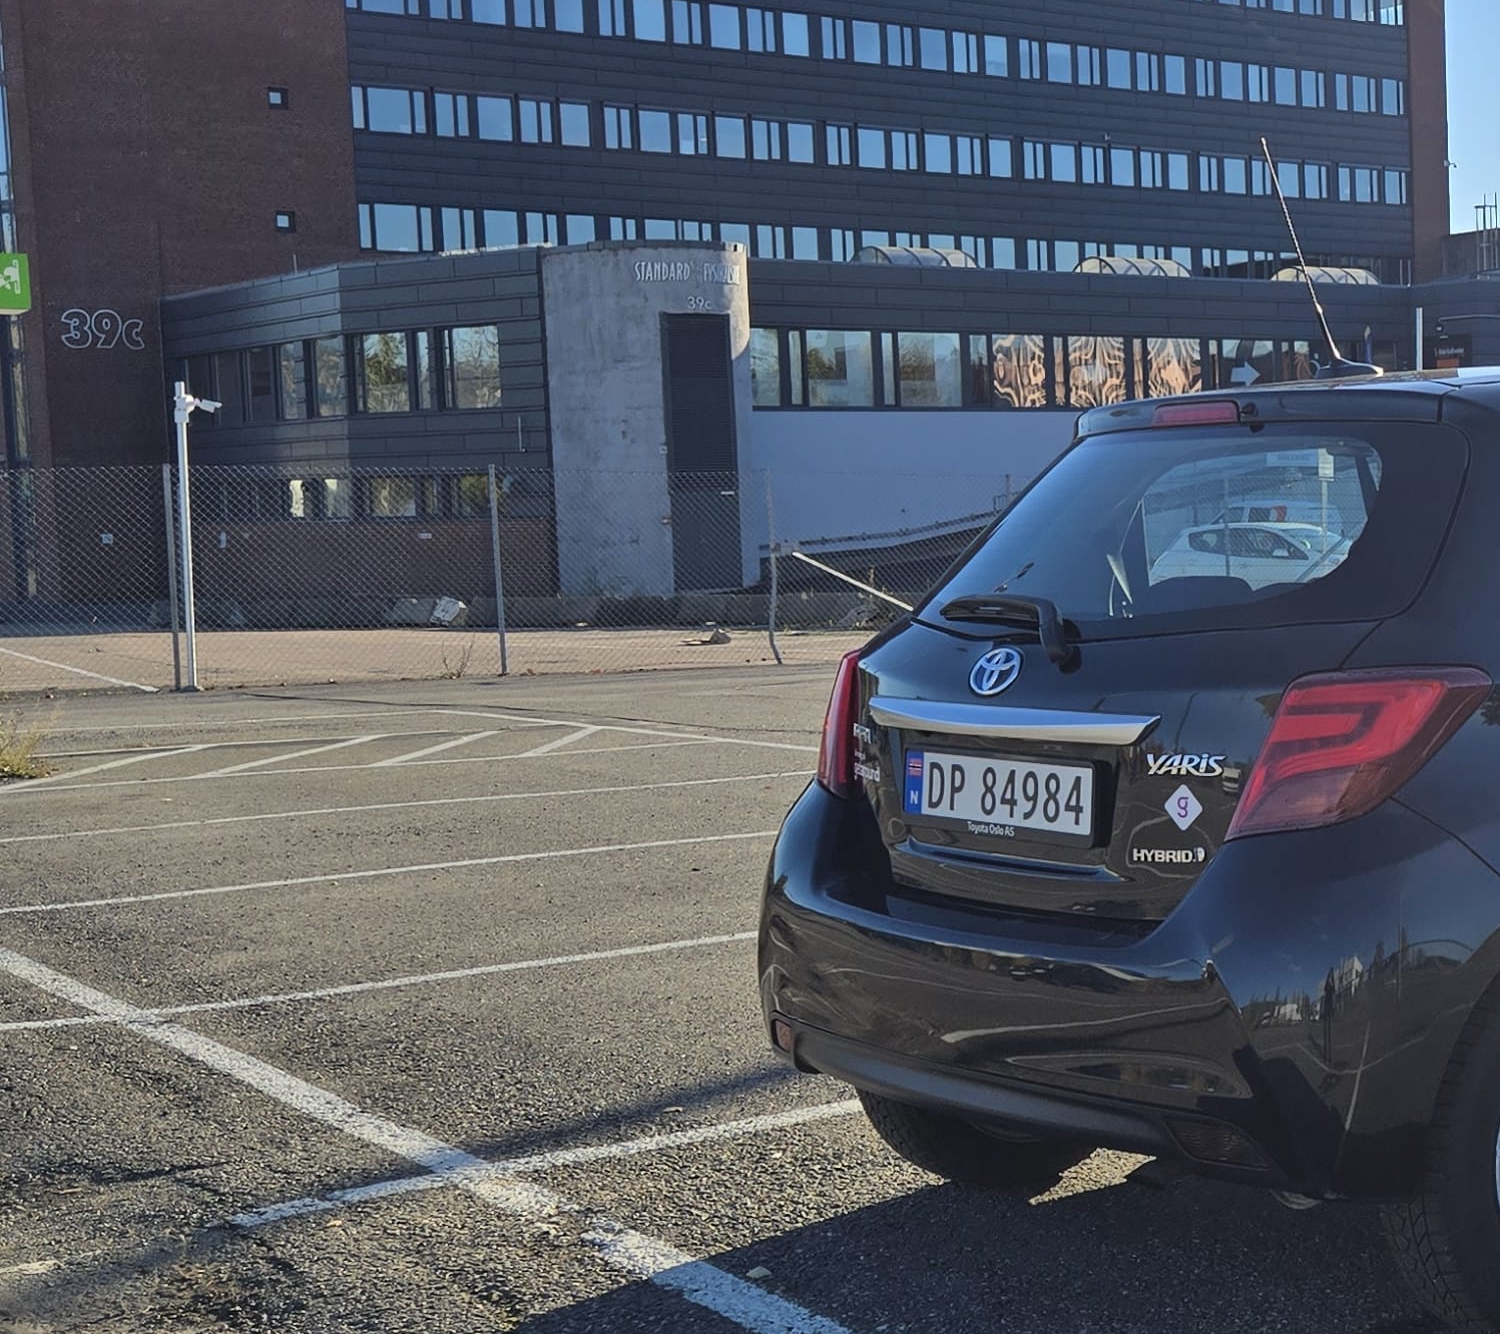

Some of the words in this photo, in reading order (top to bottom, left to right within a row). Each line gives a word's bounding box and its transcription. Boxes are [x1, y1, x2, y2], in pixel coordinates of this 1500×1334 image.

[634, 260, 690, 283] STANDARD
[687, 296, 712, 310] 39c
[61, 308, 144, 350] 39c
[909, 788, 920, 805] N
[926, 760, 966, 812] DP
[981, 766, 1085, 827] 84984
[967, 821, 988, 835] Toyota
[989, 824, 1004, 835] Oslo
[1005, 826, 1016, 837] AS
[1133, 848, 1193, 863] HYBRID
